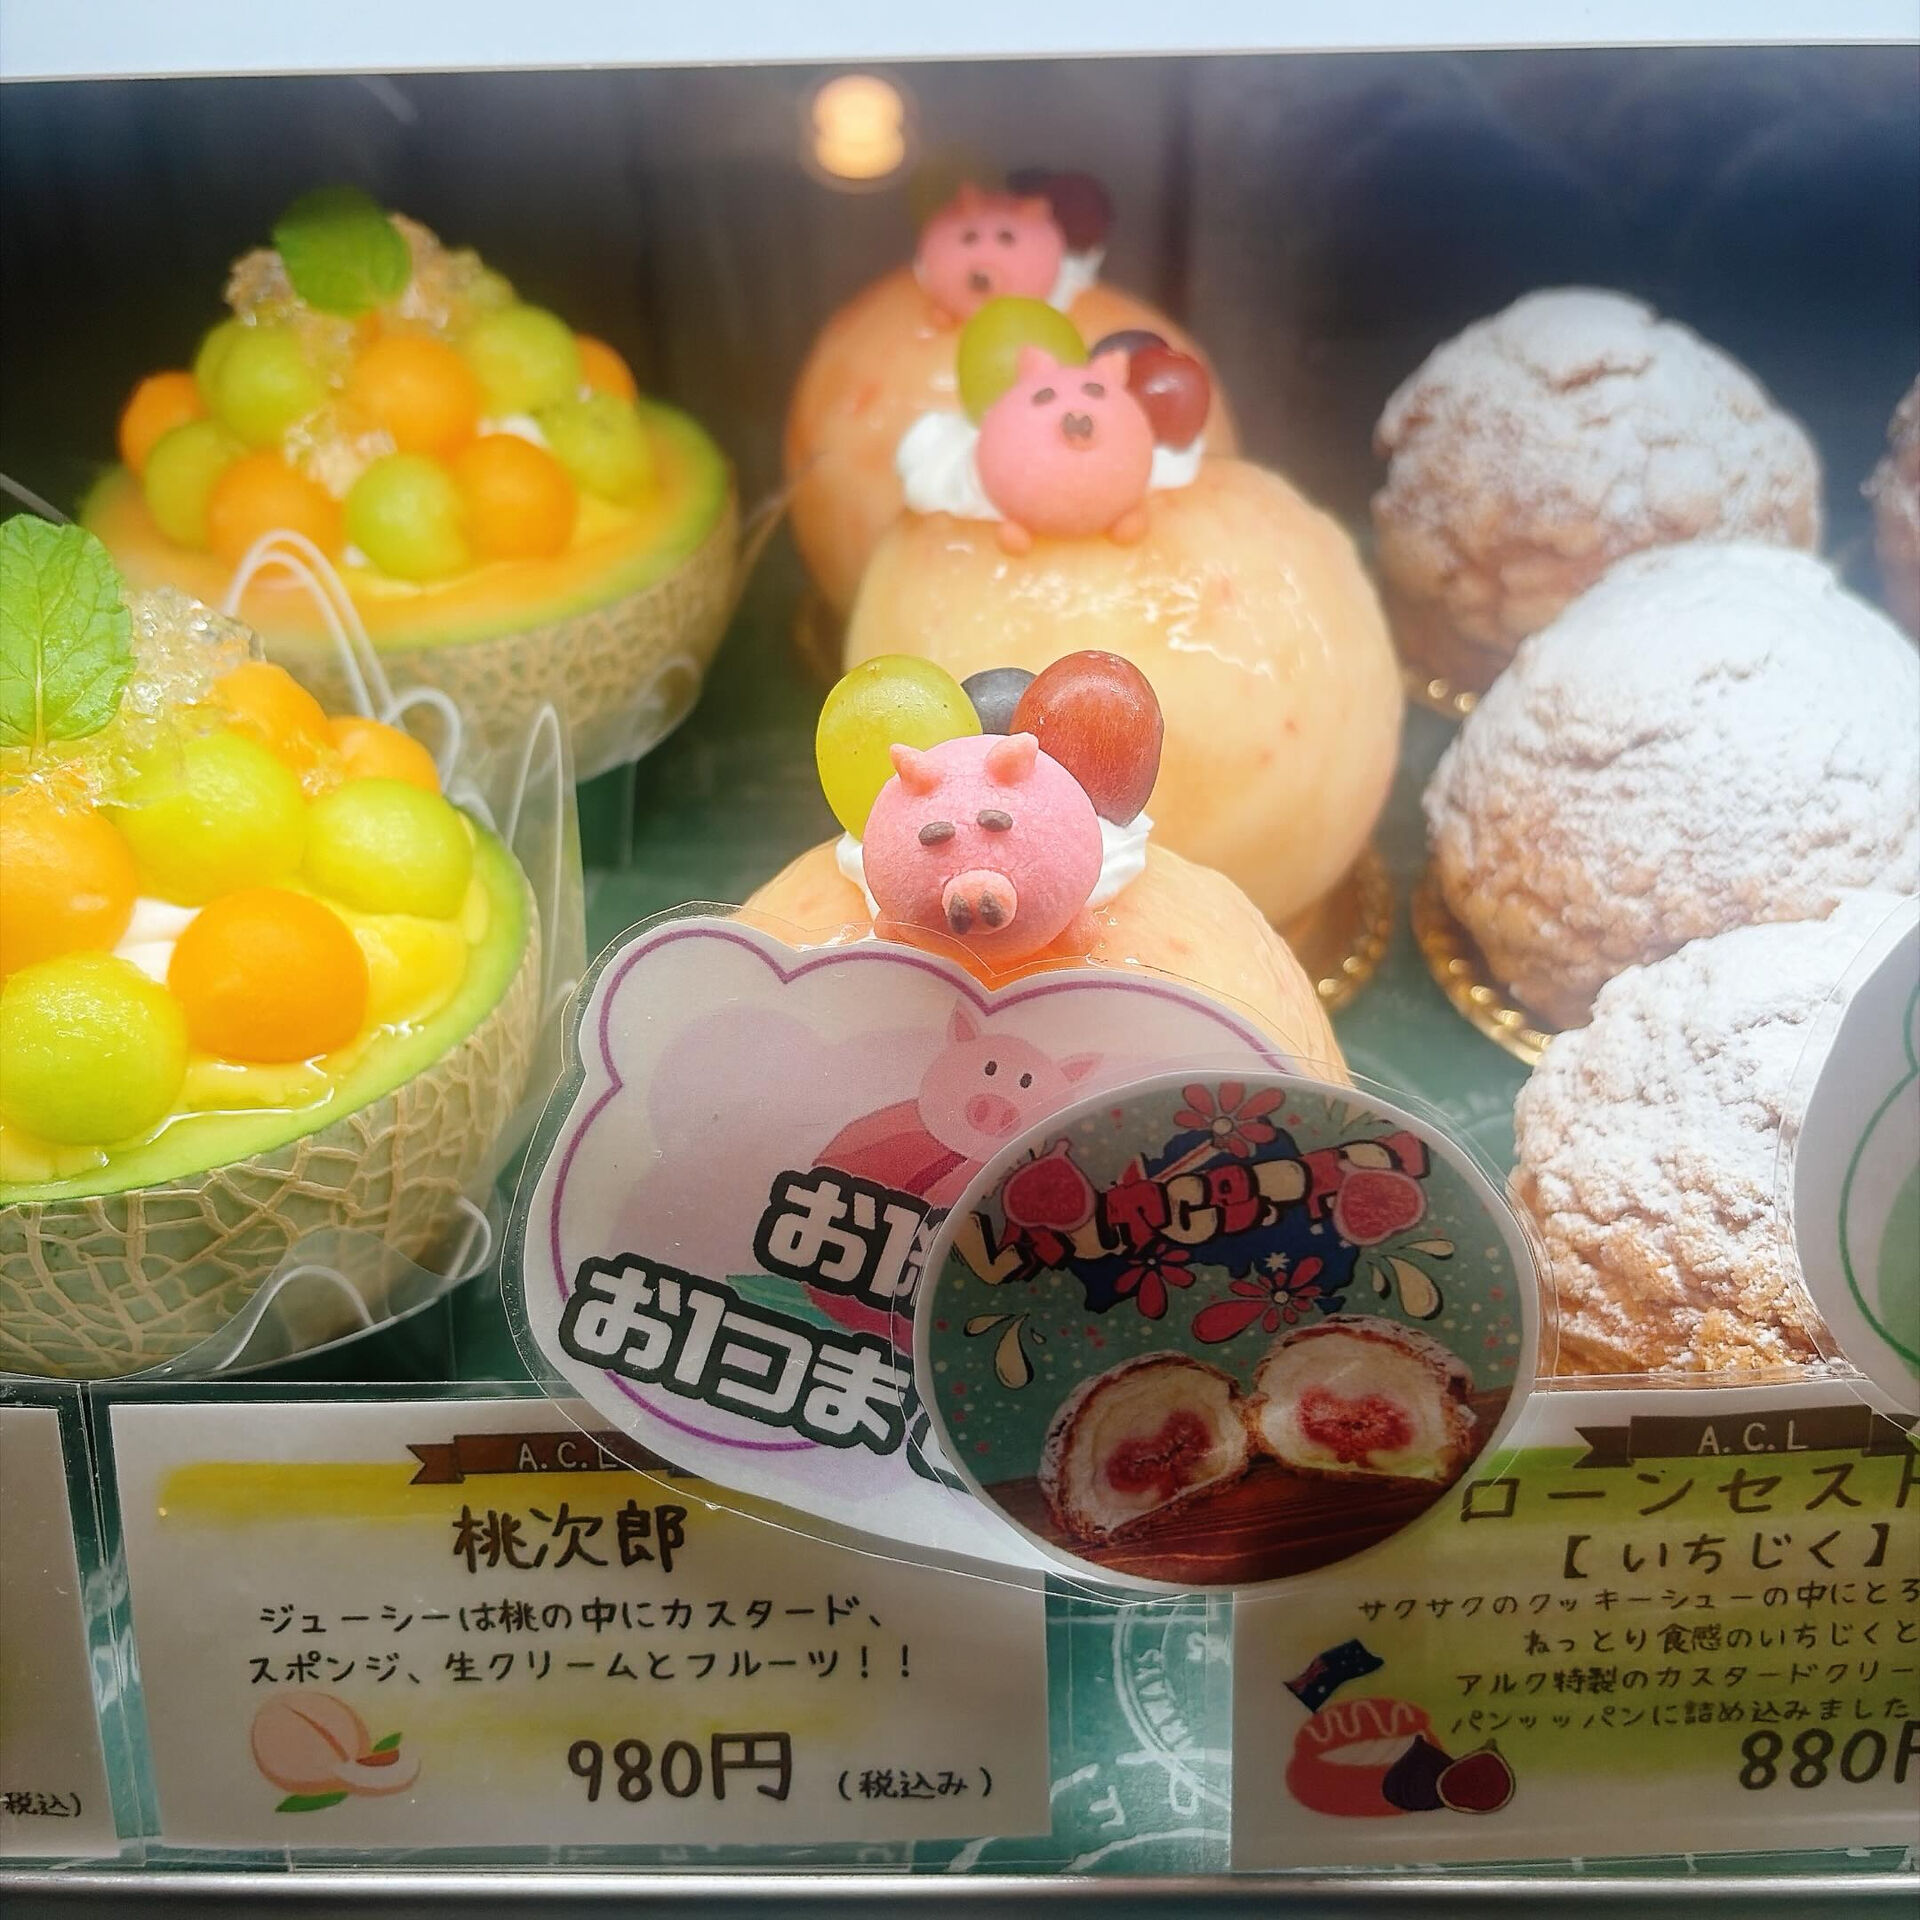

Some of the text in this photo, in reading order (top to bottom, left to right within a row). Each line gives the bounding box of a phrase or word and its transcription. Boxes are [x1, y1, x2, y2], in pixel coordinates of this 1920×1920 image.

[518, 1440, 618, 1472] A.C.L
[1698, 1419, 1808, 1454] A.C.L
[452, 1499, 687, 1573] 桃次郎
[567, 1732, 794, 1803] 980円
